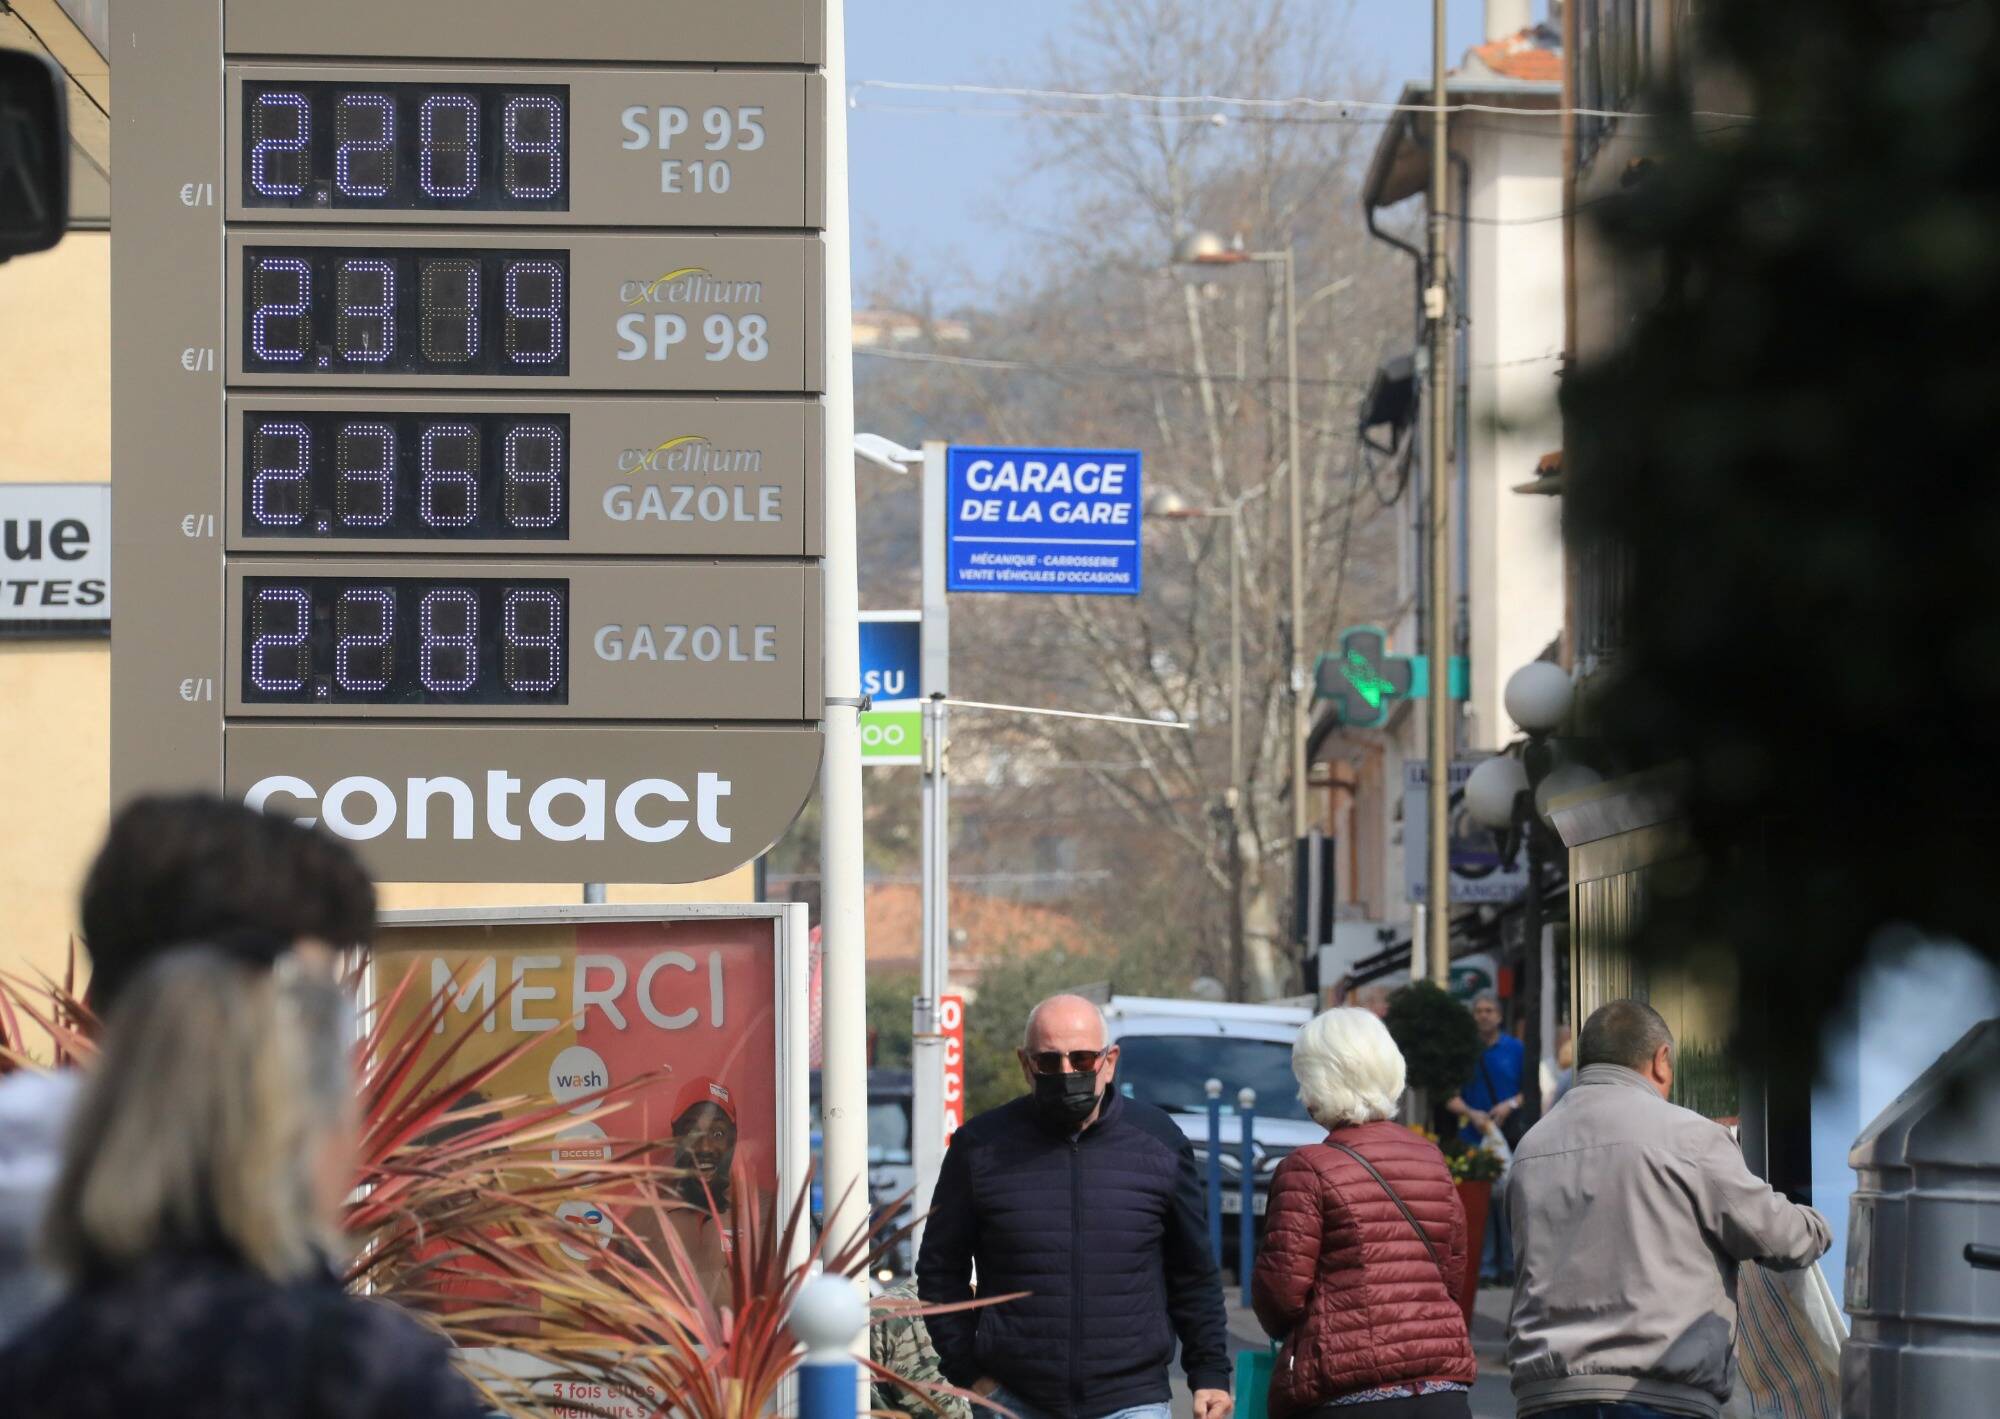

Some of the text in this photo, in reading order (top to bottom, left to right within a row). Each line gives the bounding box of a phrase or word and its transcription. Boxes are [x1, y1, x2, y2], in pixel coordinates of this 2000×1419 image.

[621, 105, 766, 151] SP 95
[661, 159, 731, 193] E10
[619, 273, 762, 304] excellium
[616, 312, 769, 362] SP 98
[618, 442, 762, 473] excellium
[966, 460, 1127, 495] GARAGE
[602, 483, 782, 522] GAZOLE
[960, 499, 1132, 525] DE LA GARE
[959, 568, 994, 581] VENTE
[996, 568, 1055, 583] VÉHICULES
[970, 552, 1037, 568] MÉCANIQUE
[1043, 554, 1119, 568] CARROSSERIE
[0, 579, 106, 606] TES
[593, 623, 777, 662] GAZOLE
[860, 669, 905, 696] SU
[243, 770, 731, 843] contact
[431, 951, 724, 1034] MERCI
[557, 1071, 602, 1088] wash
[568, 1383, 601, 1399] fois
